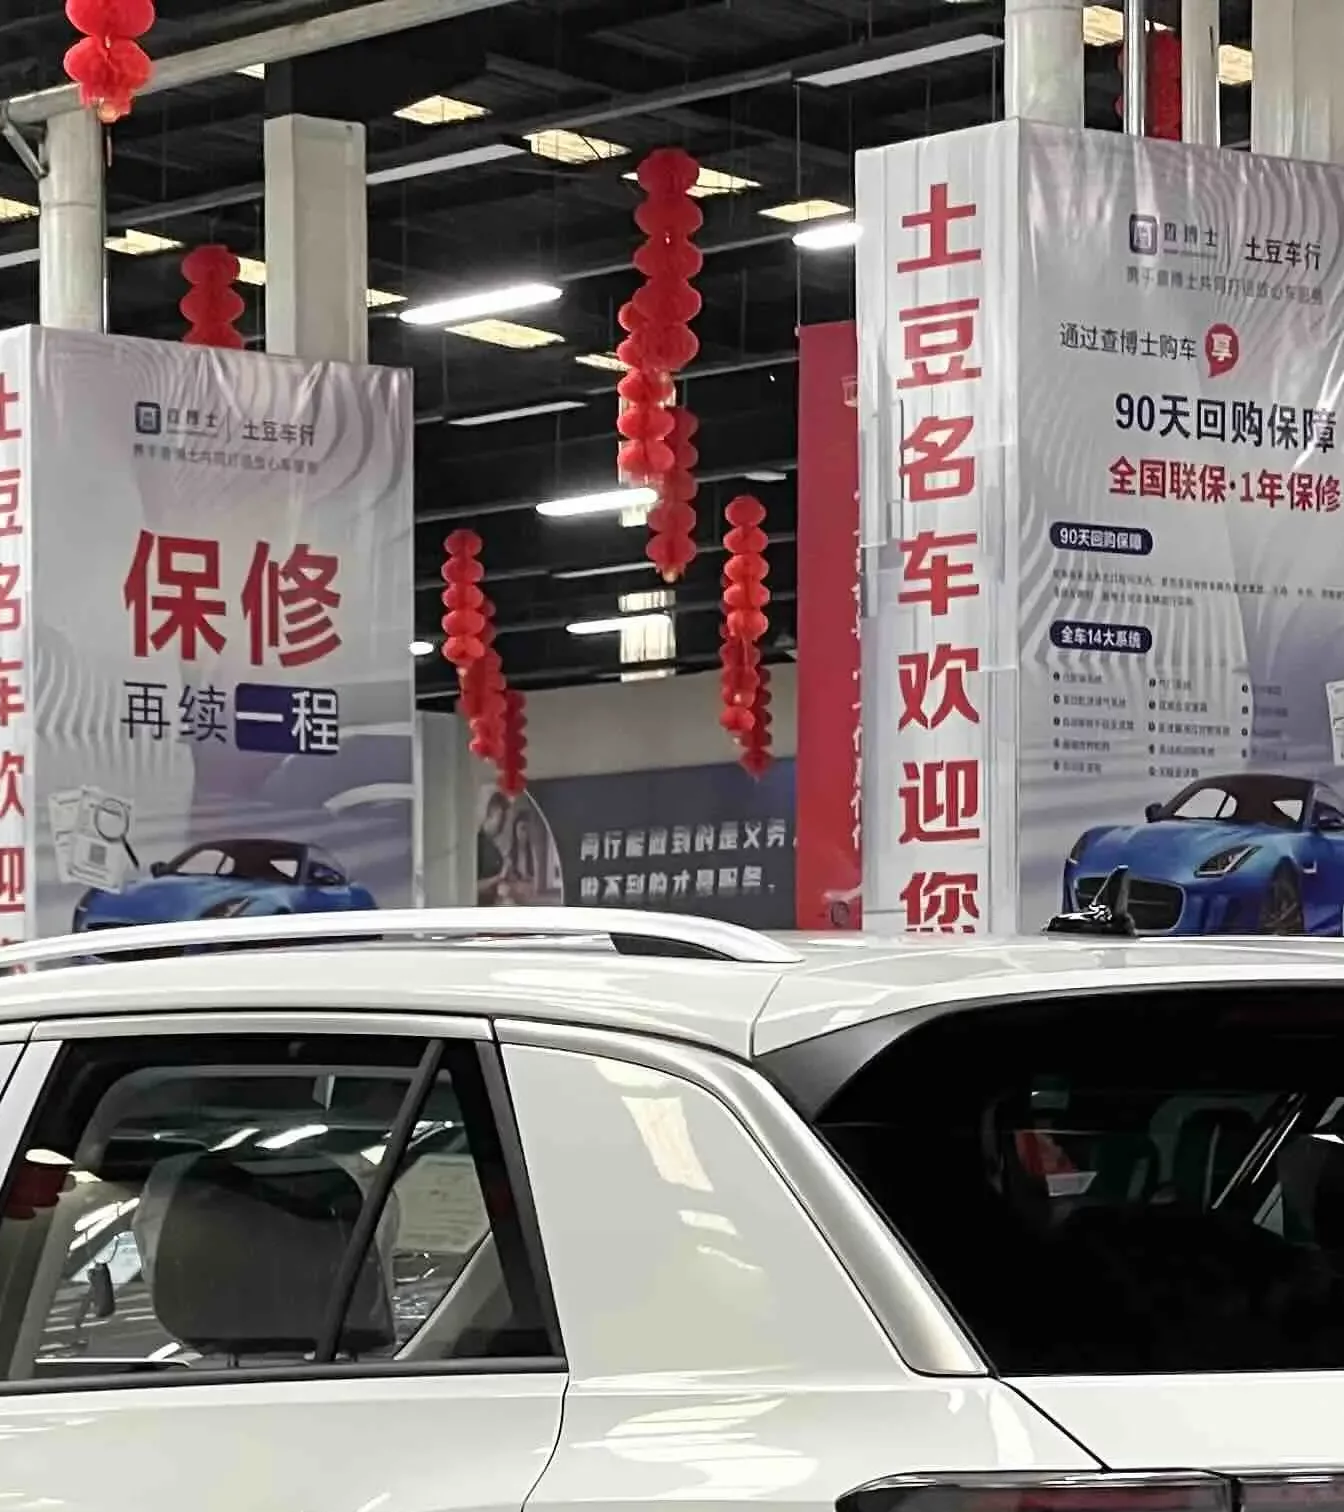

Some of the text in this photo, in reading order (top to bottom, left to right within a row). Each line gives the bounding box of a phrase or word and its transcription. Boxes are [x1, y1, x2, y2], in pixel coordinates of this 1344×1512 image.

[1244, 235, 1322, 271] 土豆车行
[1059, 321, 1198, 361] 通过查博士购车
[242, 420, 315, 447] 土豆车行
[1115, 393, 1337, 453] 90天回购保障
[1109, 456, 1341, 513] 全国联保·1年保修
[896, 183, 981, 933] 土豆名车欢迎您
[123, 529, 342, 668] 保修
[120, 680, 340, 752] 再续一程
